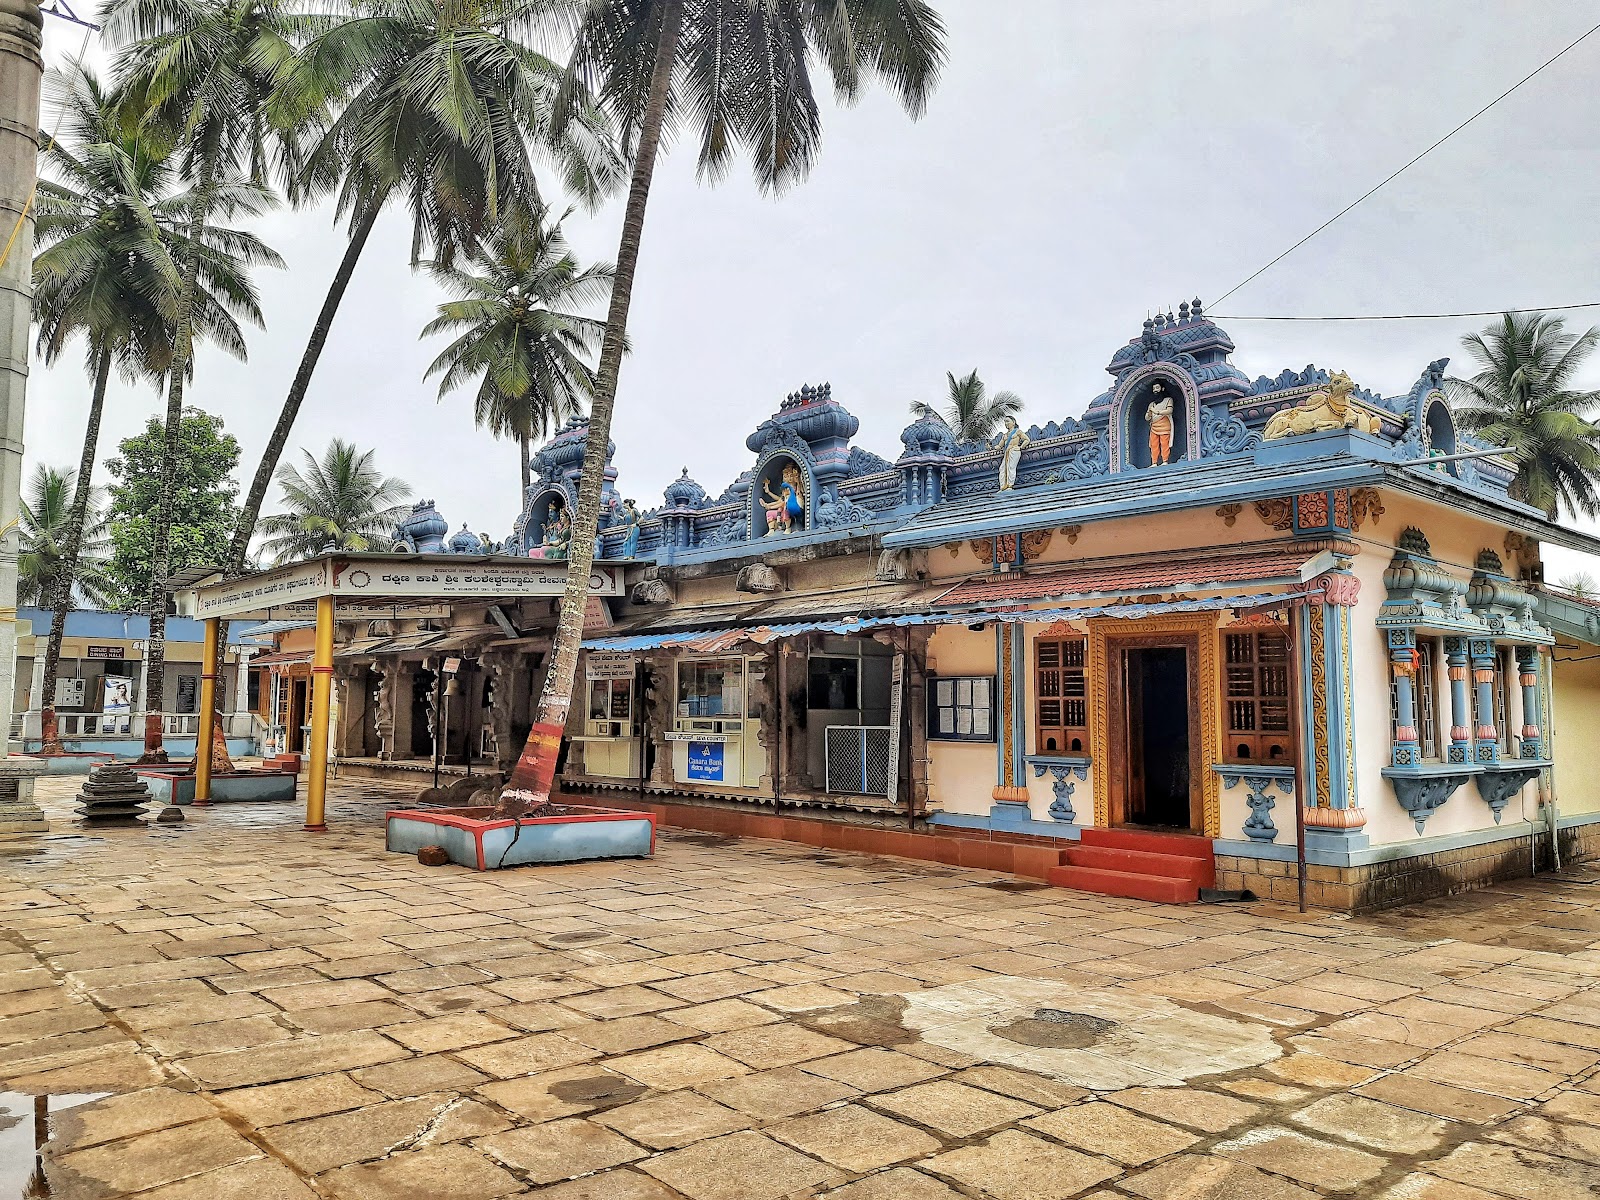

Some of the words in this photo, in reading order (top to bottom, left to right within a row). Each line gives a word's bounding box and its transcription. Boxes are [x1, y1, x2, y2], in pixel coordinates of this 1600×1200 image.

[382, 574, 410, 585] ದಕ್ಷಿಣ
[416, 574, 439, 582] ಕಾಶಿ
[445, 574, 459, 585] ಶ್ರೀ
[688, 757, 708, 765] Canara
[708, 758, 723, 766] Bank
